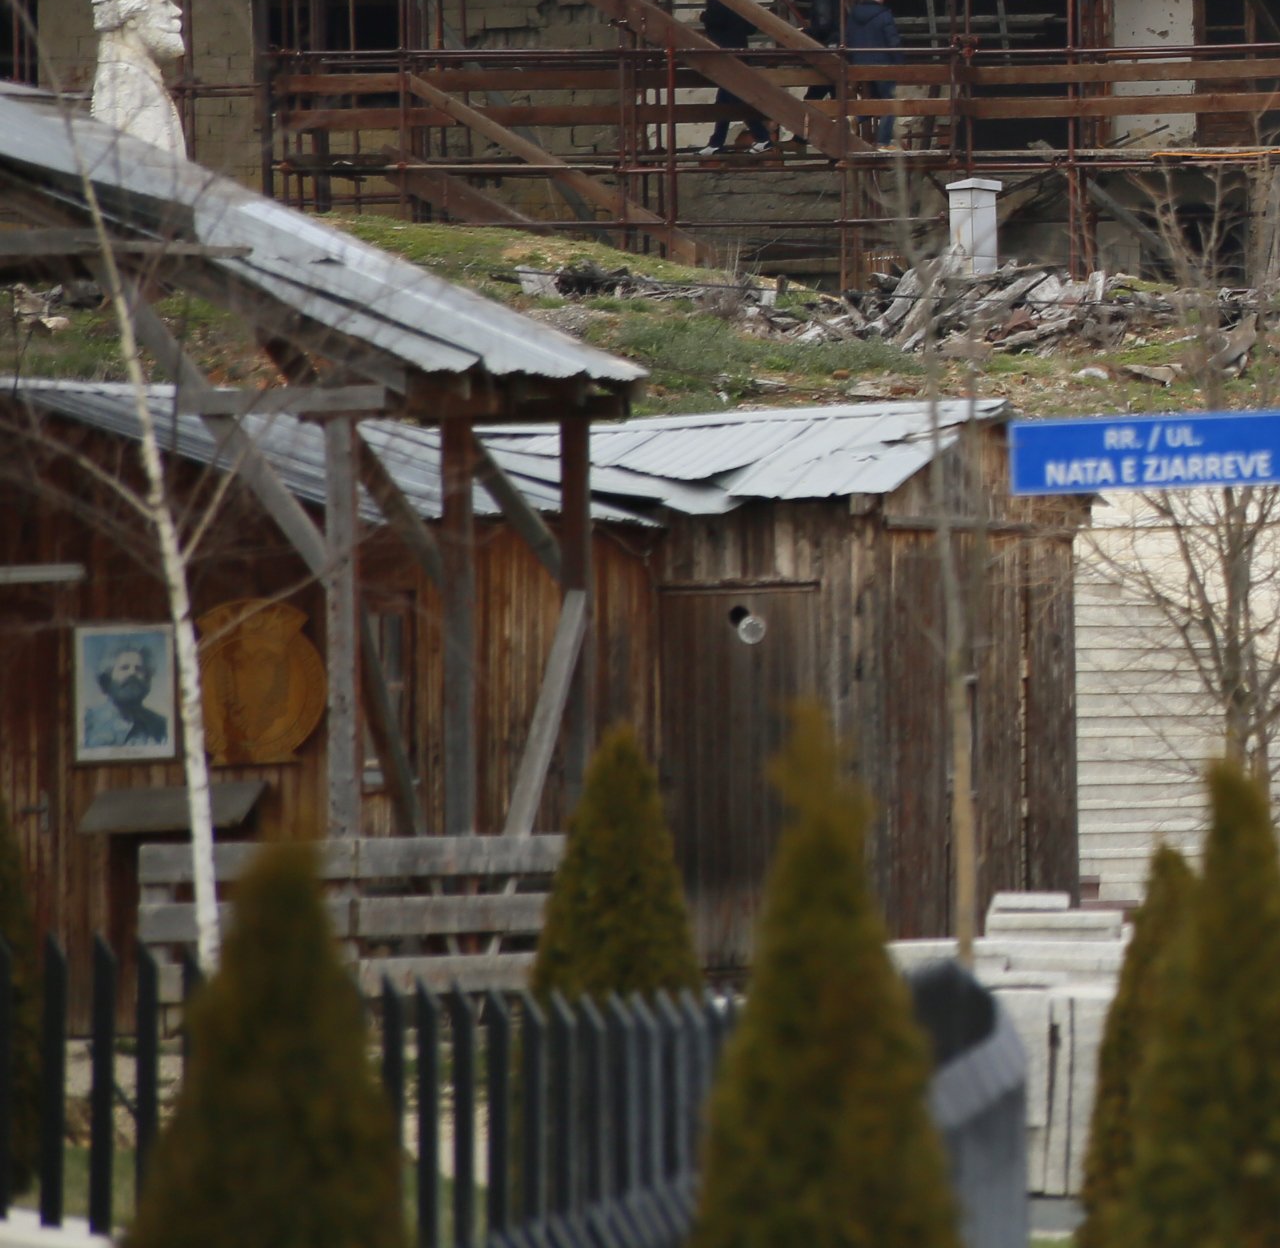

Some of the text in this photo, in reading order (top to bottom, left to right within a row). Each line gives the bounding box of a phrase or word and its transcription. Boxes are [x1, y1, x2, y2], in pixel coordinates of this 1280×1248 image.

[1103, 427, 1143, 450] RR.
[1165, 425, 1204, 448] UL.
[1045, 450, 1273, 486] NATA E ZJARREVE
